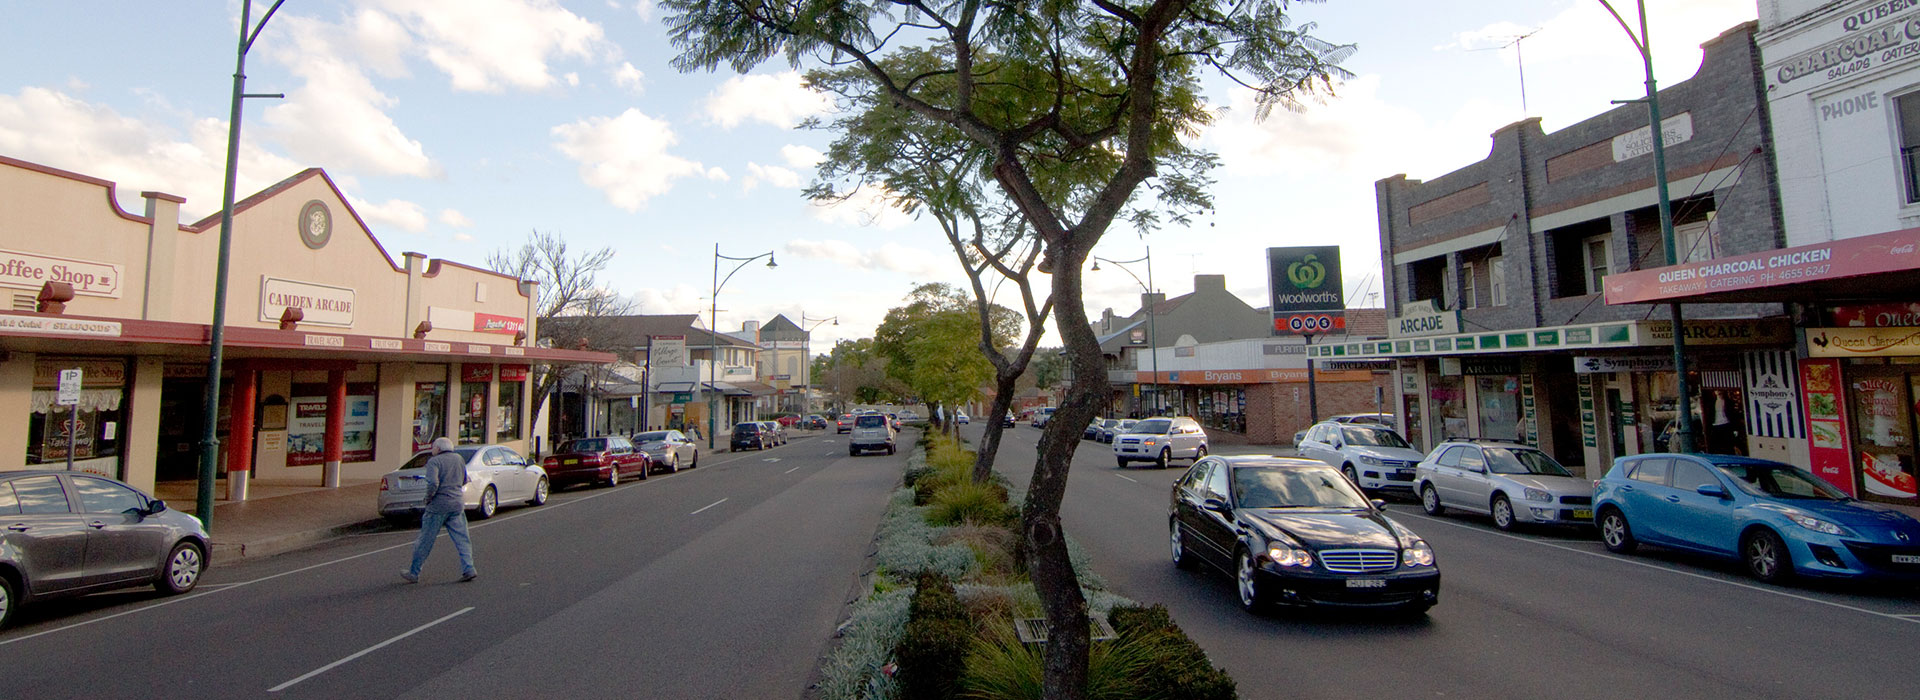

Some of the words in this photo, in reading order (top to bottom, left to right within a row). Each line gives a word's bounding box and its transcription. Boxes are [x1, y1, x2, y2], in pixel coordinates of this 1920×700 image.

[1777, 24, 1903, 84] CHARCOAL
[1827, 57, 1871, 80] SALADS
[1821, 91, 1879, 121] PHONE
[1658, 268, 1696, 284] QUEEN
[1698, 258, 1766, 278] CHARCOAL
[1767, 247, 1832, 269] CHICKEN
[50, 264, 95, 290] Shop
[1659, 281, 1702, 295] TAKEAWAY
[1710, 274, 1756, 289] CATERING
[1778, 268, 1803, 281] 4655
[1805, 264, 1832, 276] 6247
[269, 292, 313, 309] CAMDEN
[315, 297, 352, 313] ARCADE
[1278, 290, 1338, 304] woolworths
[1293, 318, 1329, 329] BWS
[1400, 315, 1443, 334] ARCADE
[1650, 324, 1673, 333] ALBER
[1682, 324, 1751, 339] ARCADE
[307, 336, 325, 345] TRAVEL
[1832, 335, 1865, 348] Queen
[1867, 335, 1909, 347] Charcoal
[1204, 370, 1242, 382] Bryans
[1271, 371, 1309, 380] Bryans
[50, 437, 95, 448] Takeway
